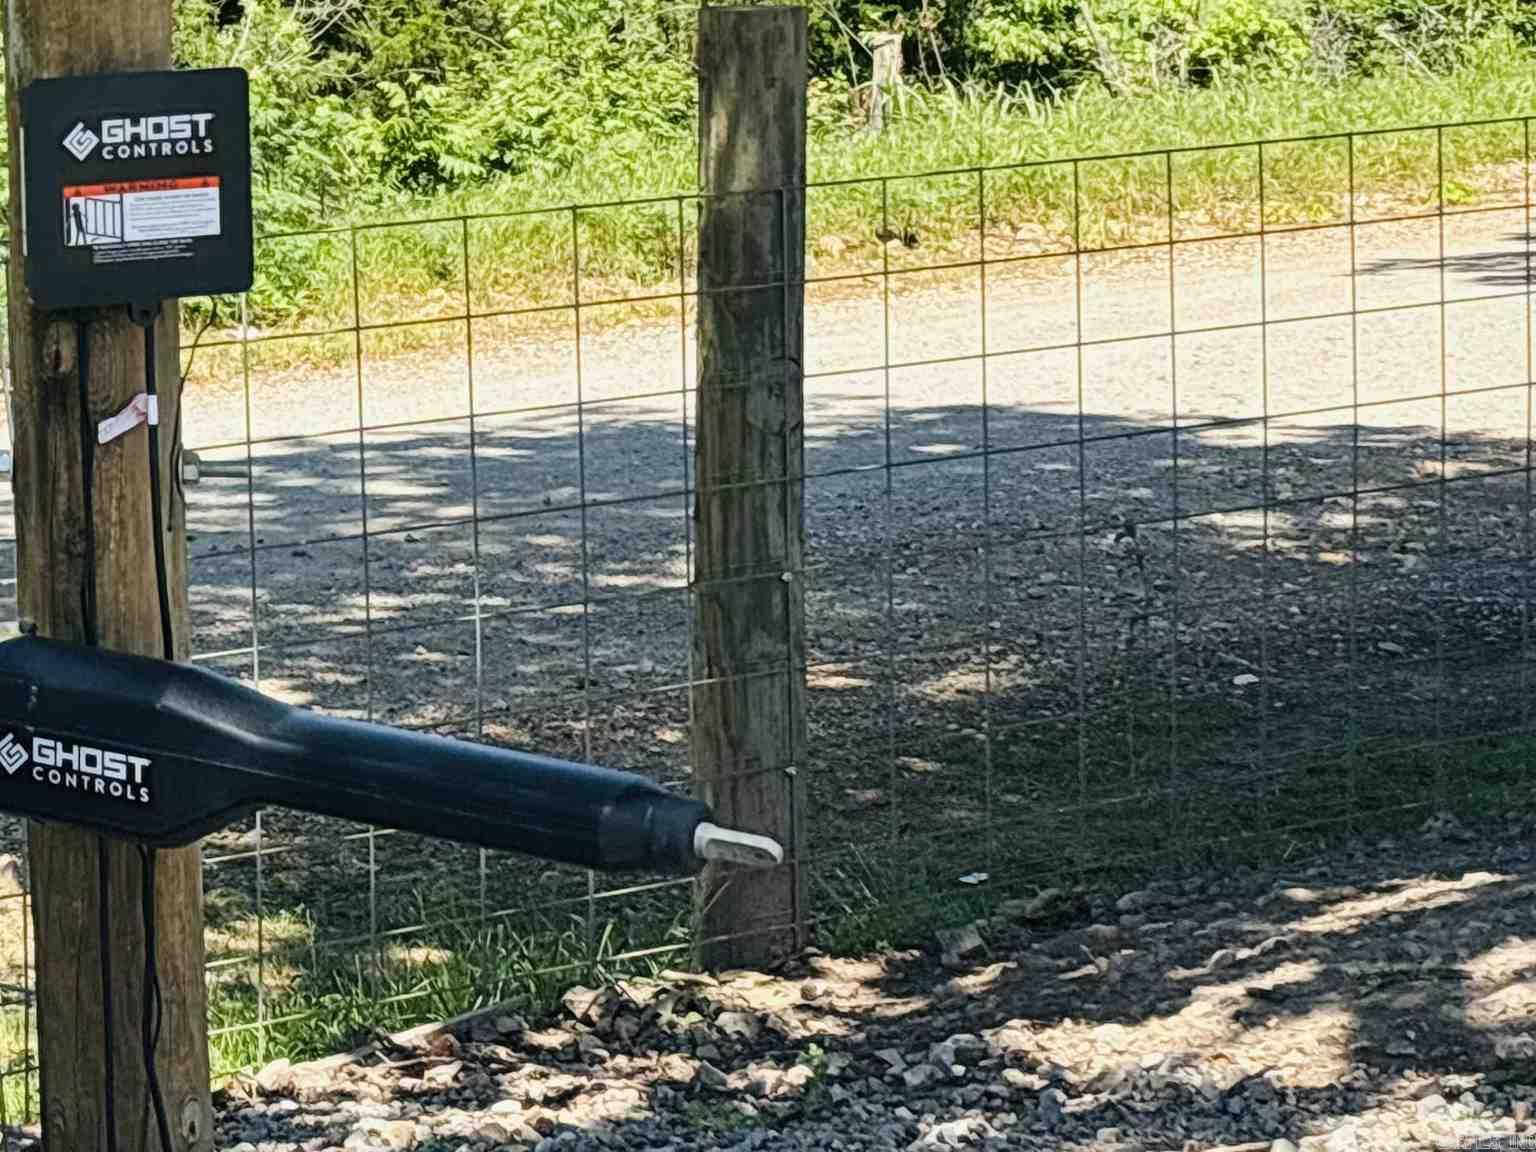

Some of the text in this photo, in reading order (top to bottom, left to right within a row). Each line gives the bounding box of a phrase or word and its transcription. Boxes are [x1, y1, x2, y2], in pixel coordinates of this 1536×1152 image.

[101, 113, 215, 144] GHOST
[102, 139, 214, 160] CONTROLS
[32, 736, 152, 783] GHOST
[32, 765, 150, 803] CONTROLS
